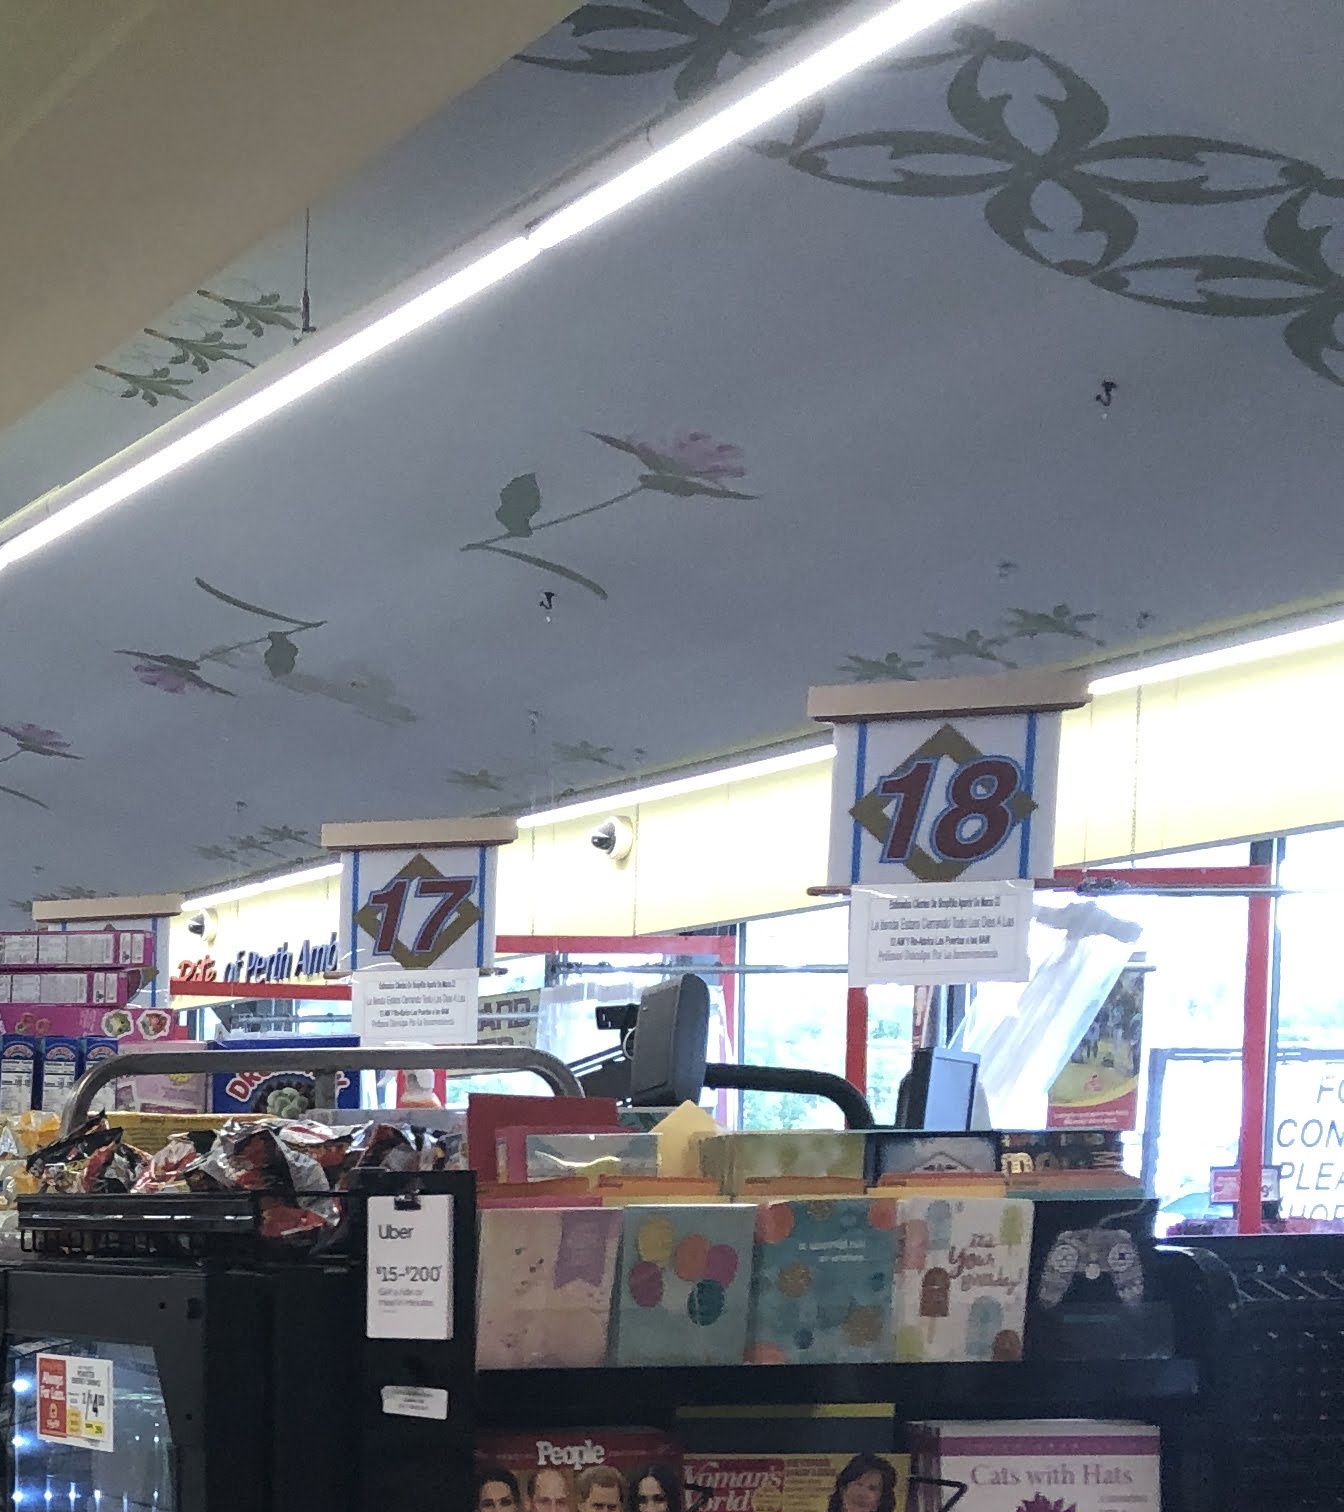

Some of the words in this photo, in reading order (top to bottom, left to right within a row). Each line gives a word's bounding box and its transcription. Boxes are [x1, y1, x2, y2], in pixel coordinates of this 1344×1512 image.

[876, 754, 1025, 865] 18
[367, 875, 478, 957] 17
[223, 951, 246, 983] of
[247, 943, 292, 984] Perth
[378, 1223, 414, 1241] Uber
[536, 1439, 606, 1470] People
[970, 1462, 1020, 1487] Cats
[1024, 1462, 1076, 1487] with
[1082, 1462, 1135, 1487] Hats
